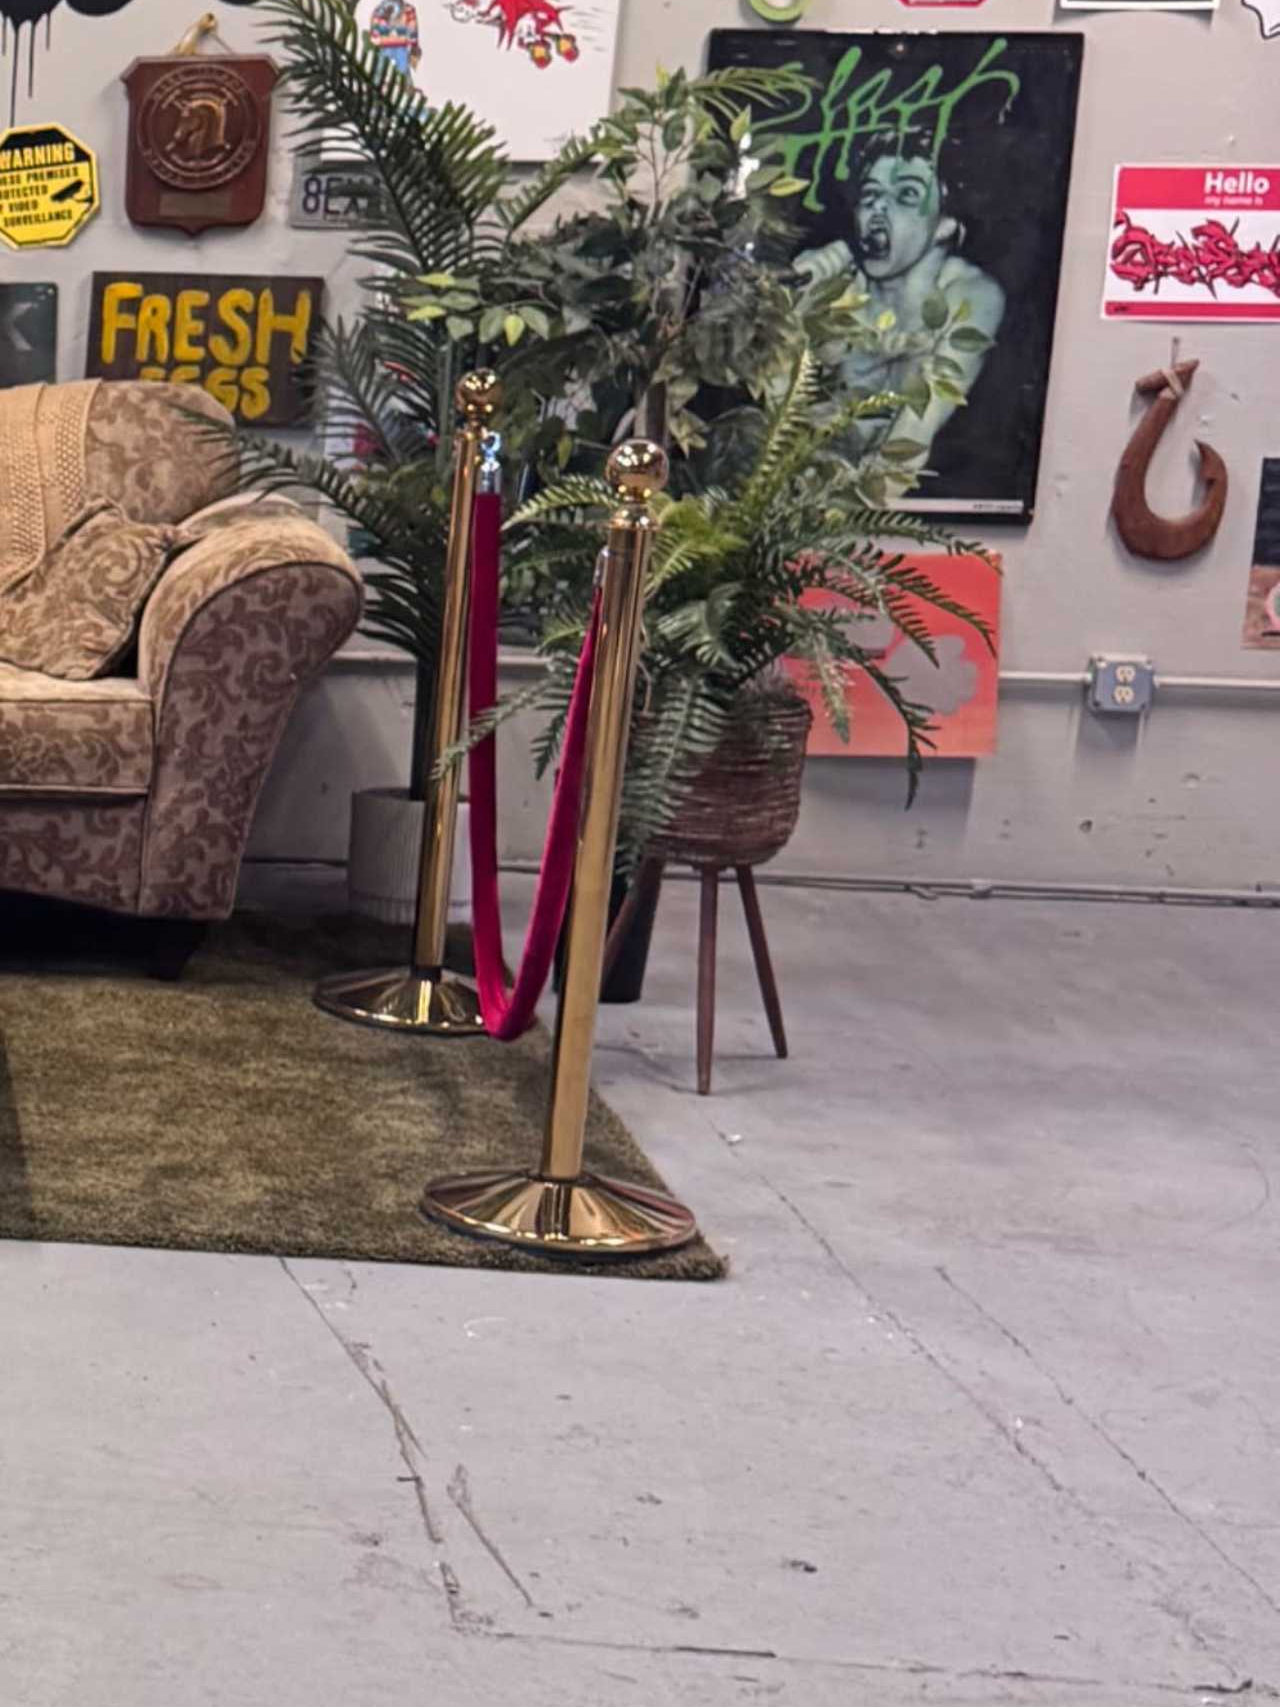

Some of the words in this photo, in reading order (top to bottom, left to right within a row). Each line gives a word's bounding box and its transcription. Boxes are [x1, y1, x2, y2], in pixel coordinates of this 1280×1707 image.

[26, 166, 79, 183] PREMISES
[1204, 171, 1270, 195] Hello
[8, 199, 38, 213] VIDEO
[3, 208, 73, 228] SURVEILLANCE
[101, 281, 312, 366] FRESH
